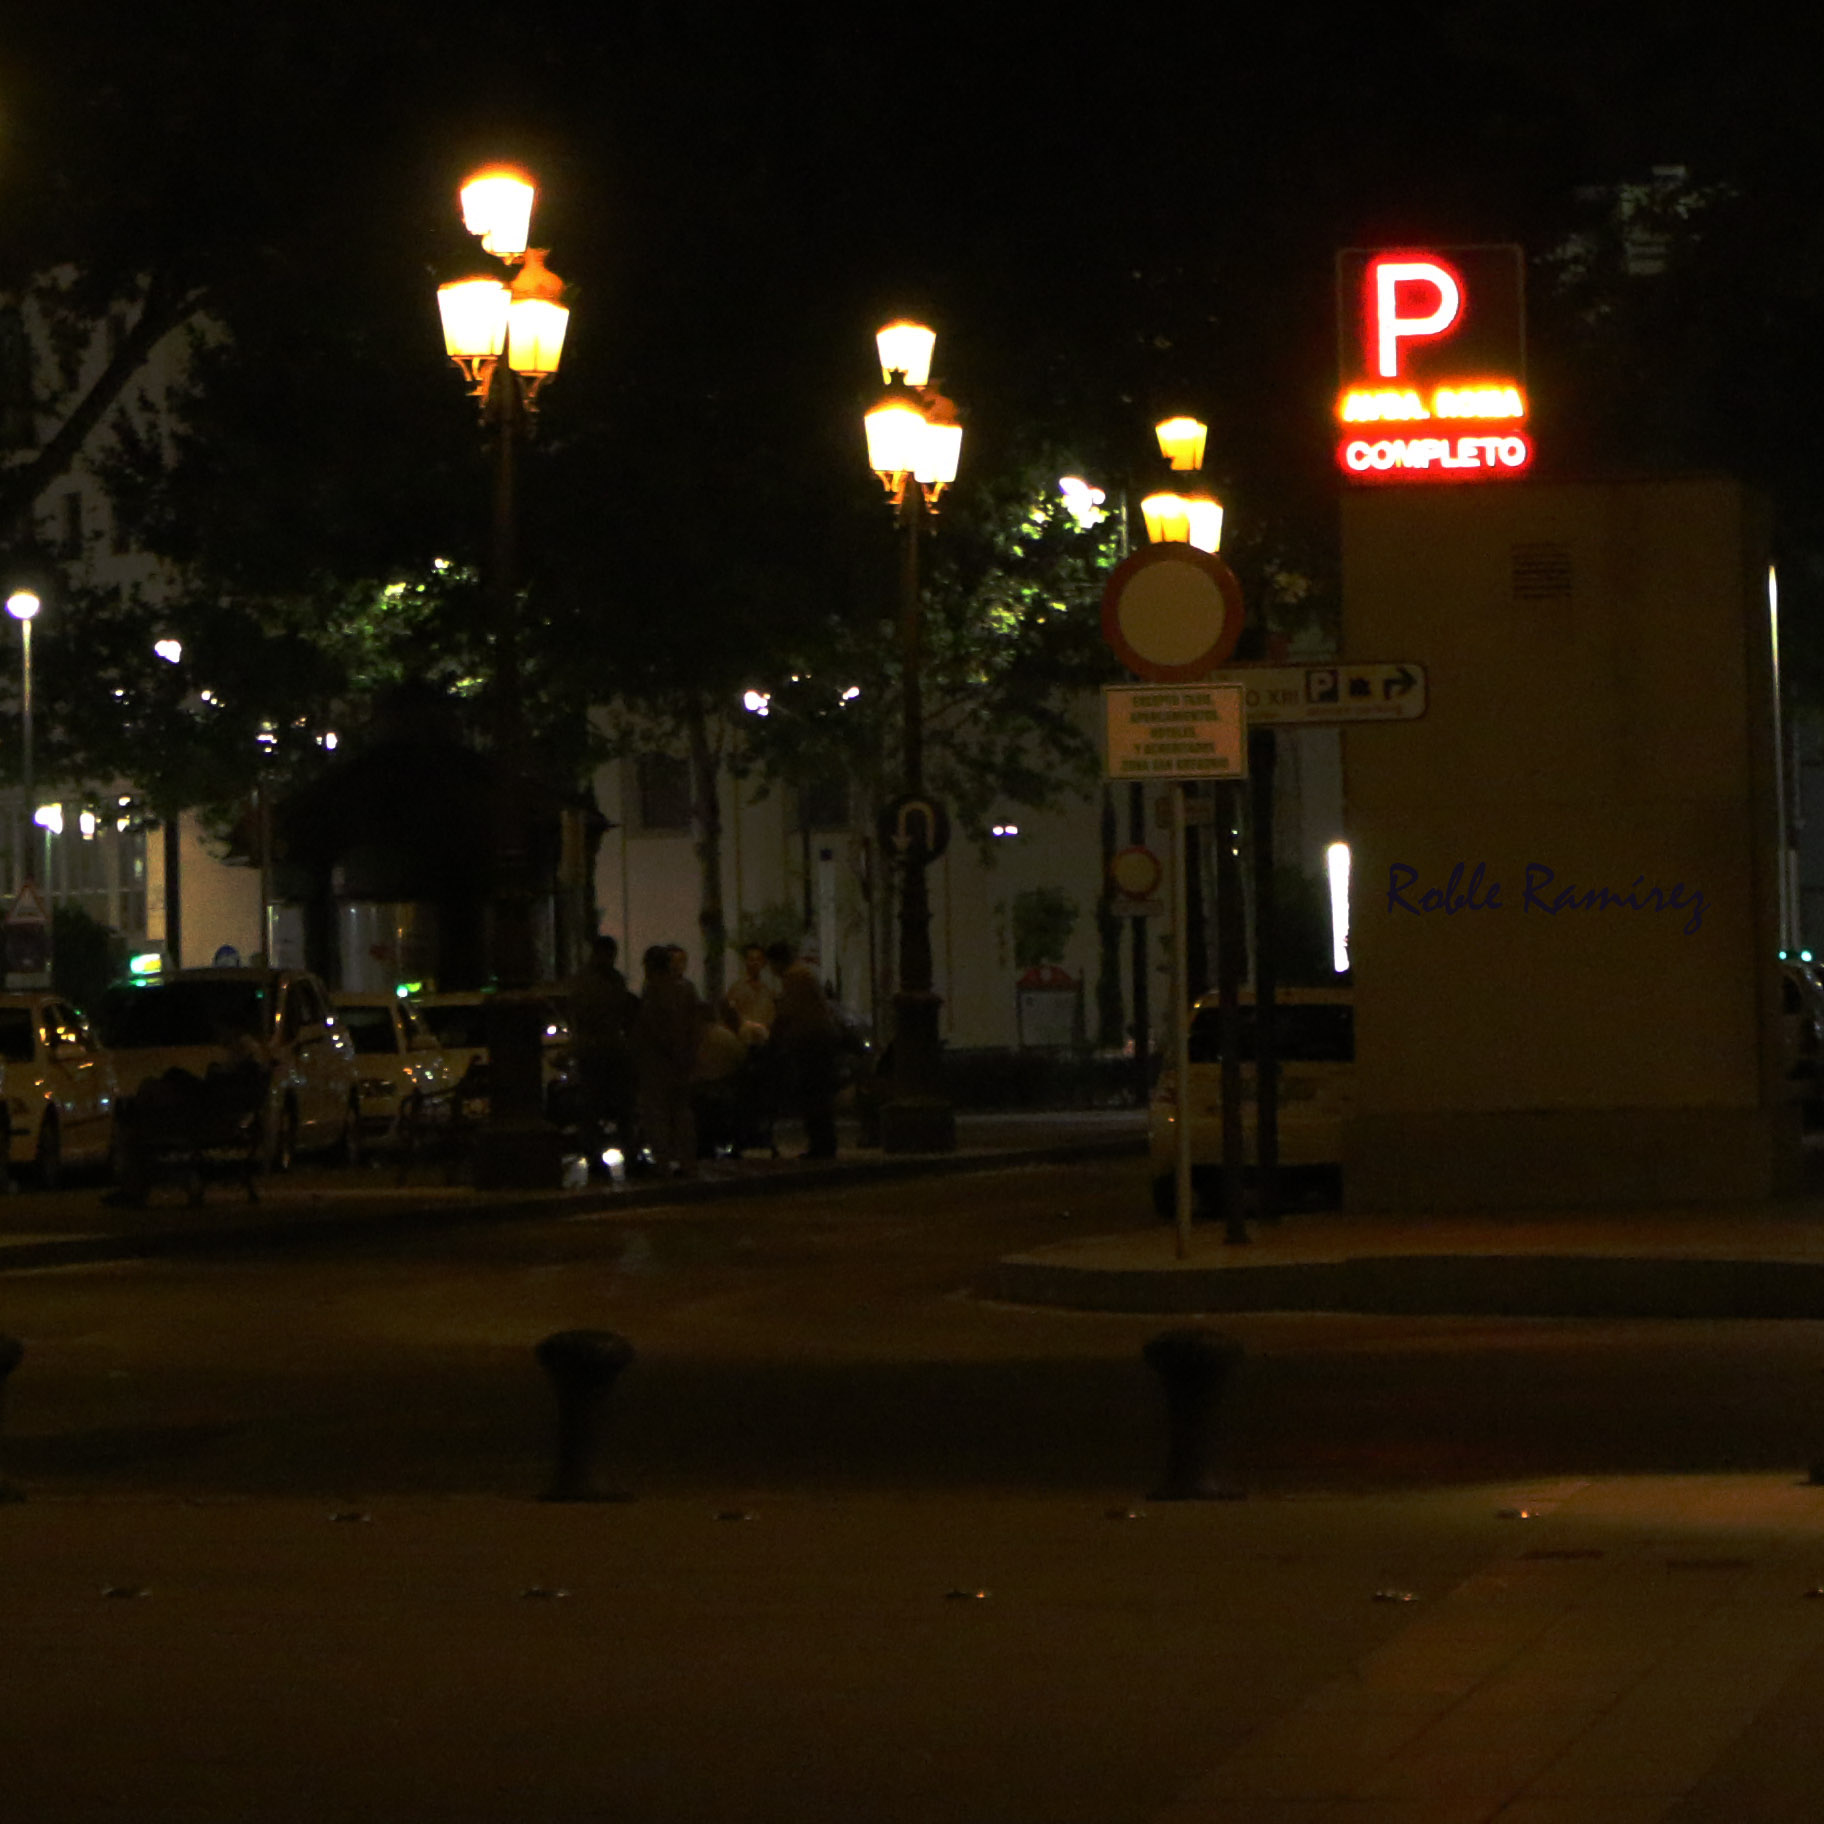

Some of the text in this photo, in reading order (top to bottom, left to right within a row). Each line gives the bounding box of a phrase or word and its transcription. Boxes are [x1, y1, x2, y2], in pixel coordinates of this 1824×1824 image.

[1374, 261, 1462, 377] P
[1345, 436, 1527, 471] COMPLETO
[1309, 671, 1334, 702] P
